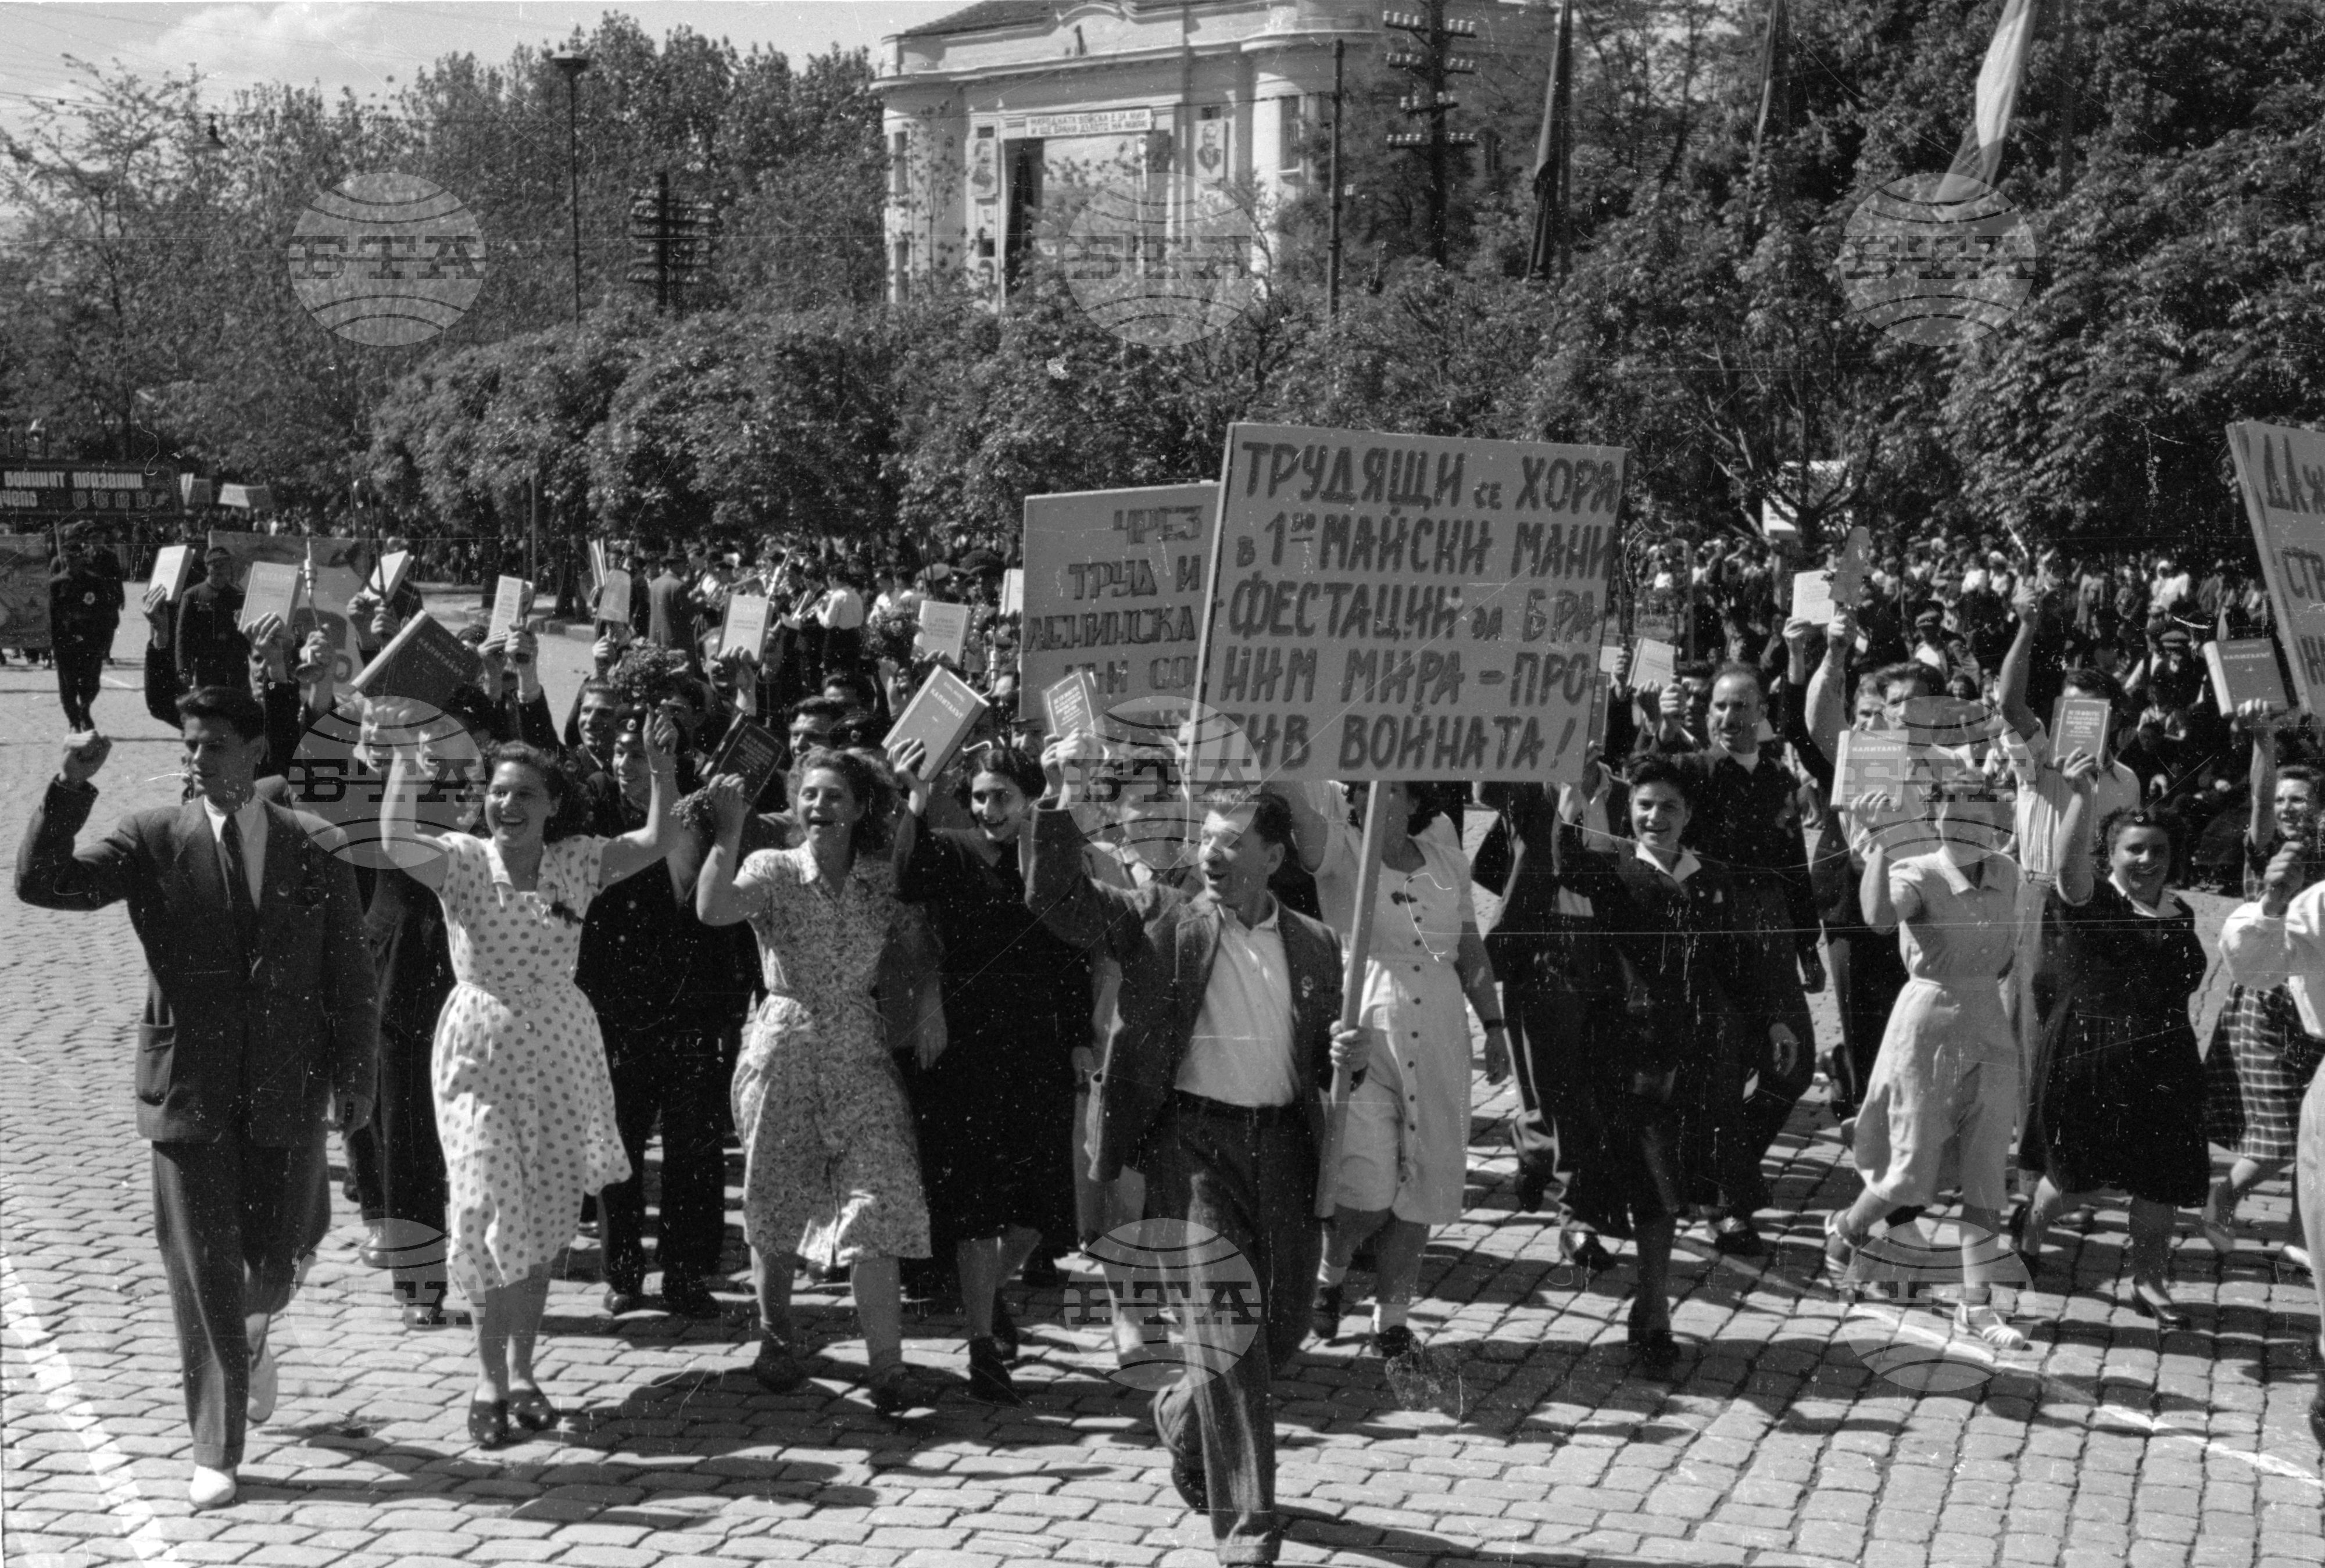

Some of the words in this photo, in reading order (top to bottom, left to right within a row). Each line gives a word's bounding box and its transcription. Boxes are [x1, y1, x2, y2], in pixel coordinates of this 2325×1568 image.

[1242, 441, 1465, 511] ТРУДЯЩИ
[1515, 456, 1621, 515] ХОРА
[1113, 505, 1203, 545] ЧРЕЗ
[1068, 559, 1157, 600] ТРУД
[1175, 555, 1201, 593] И
[1021, 606, 1196, 652] ЛЕНИНСКА
[1150, 656, 1199, 690] СО
[1220, 646, 1318, 703] НИМ
[1340, 647, 1465, 705] МИРА
